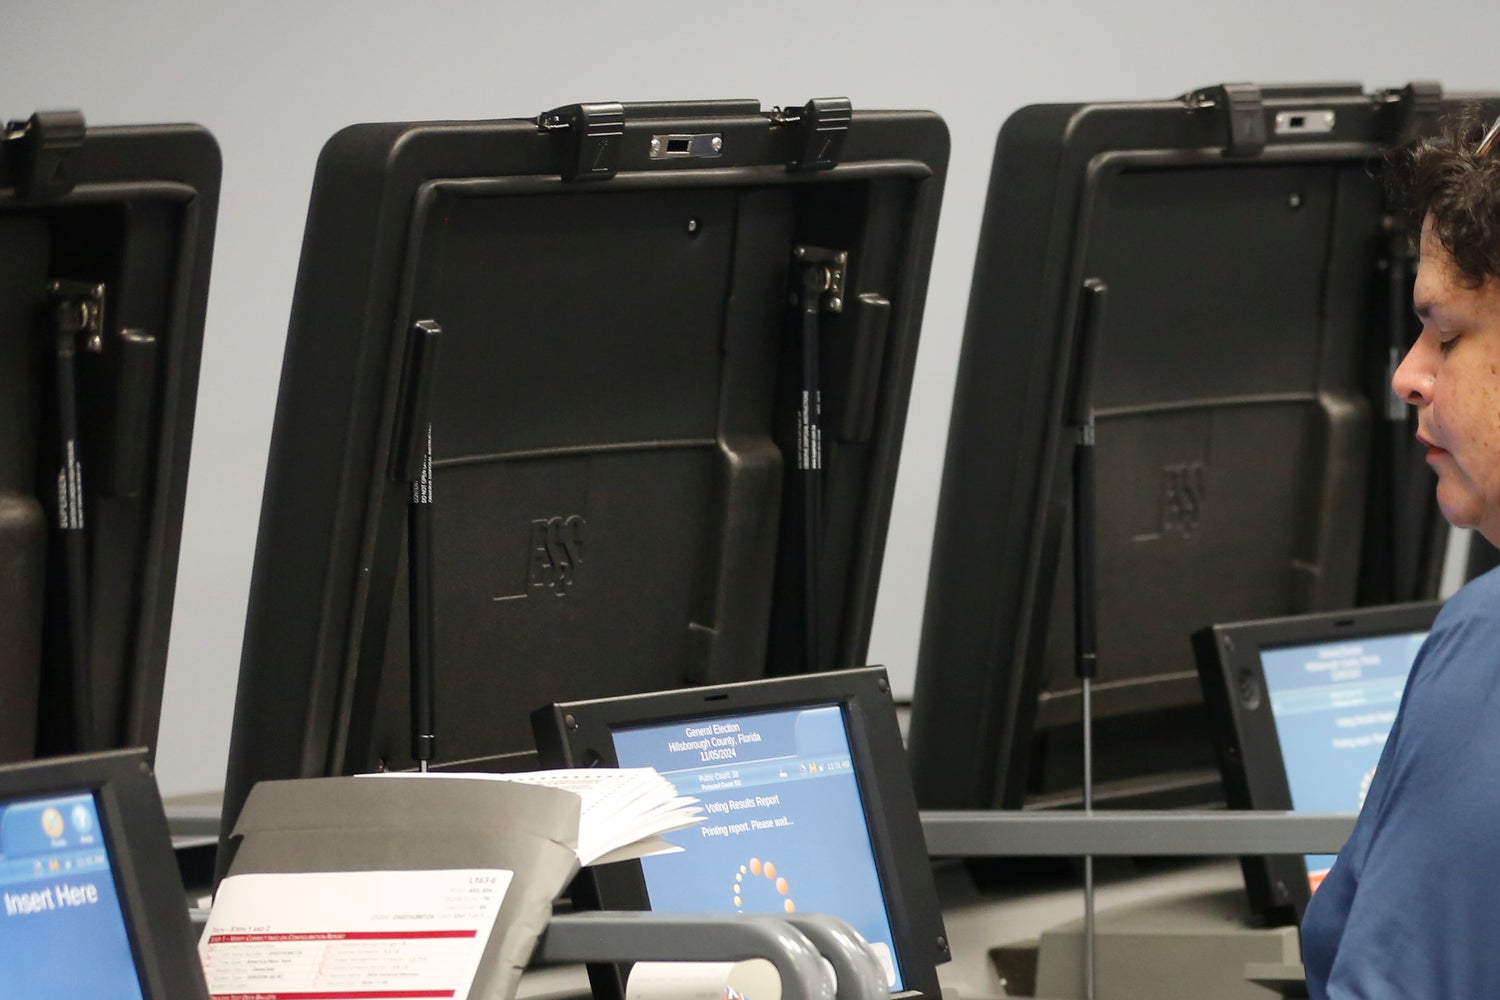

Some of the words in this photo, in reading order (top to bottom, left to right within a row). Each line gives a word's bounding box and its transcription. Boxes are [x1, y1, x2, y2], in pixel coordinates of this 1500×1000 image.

[685, 725, 712, 737] General
[713, 723, 740, 734] Election
[668, 738, 711, 752] Hillsborough
[712, 736, 738, 748] County,
[738, 732, 761, 744] Florida
[700, 749, 737, 761] 11/05/2024
[705, 801, 729, 814] Voting
[729, 798, 754, 811] Results
[755, 795, 780, 808] Report
[702, 825, 729, 837] Printing
[751, 818, 774, 830] Please
[4, 888, 55, 916] Insert
[55, 883, 98, 908] Here
